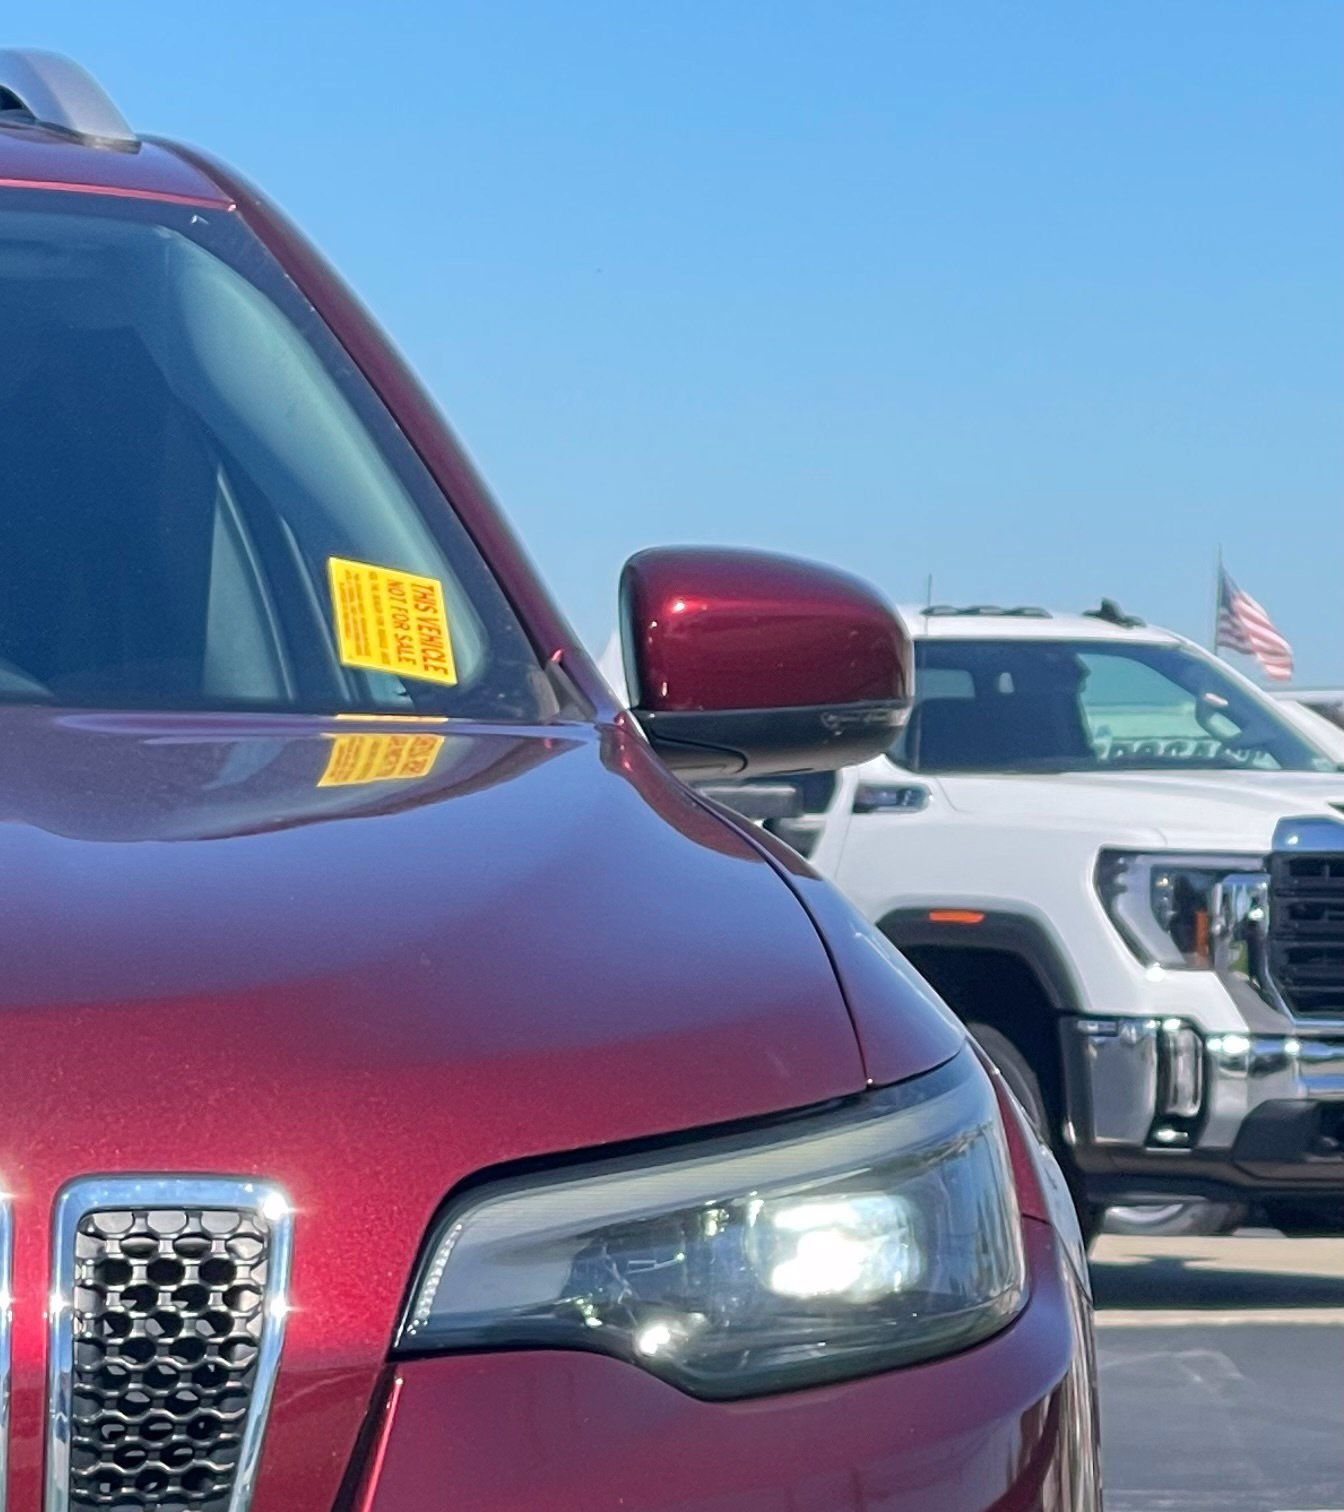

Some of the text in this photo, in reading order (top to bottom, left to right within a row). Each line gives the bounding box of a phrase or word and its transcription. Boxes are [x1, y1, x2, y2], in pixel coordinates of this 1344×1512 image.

[387, 580, 416, 665] NOT FOR SALE
[411, 584, 448, 675] THIS VEHICLE
